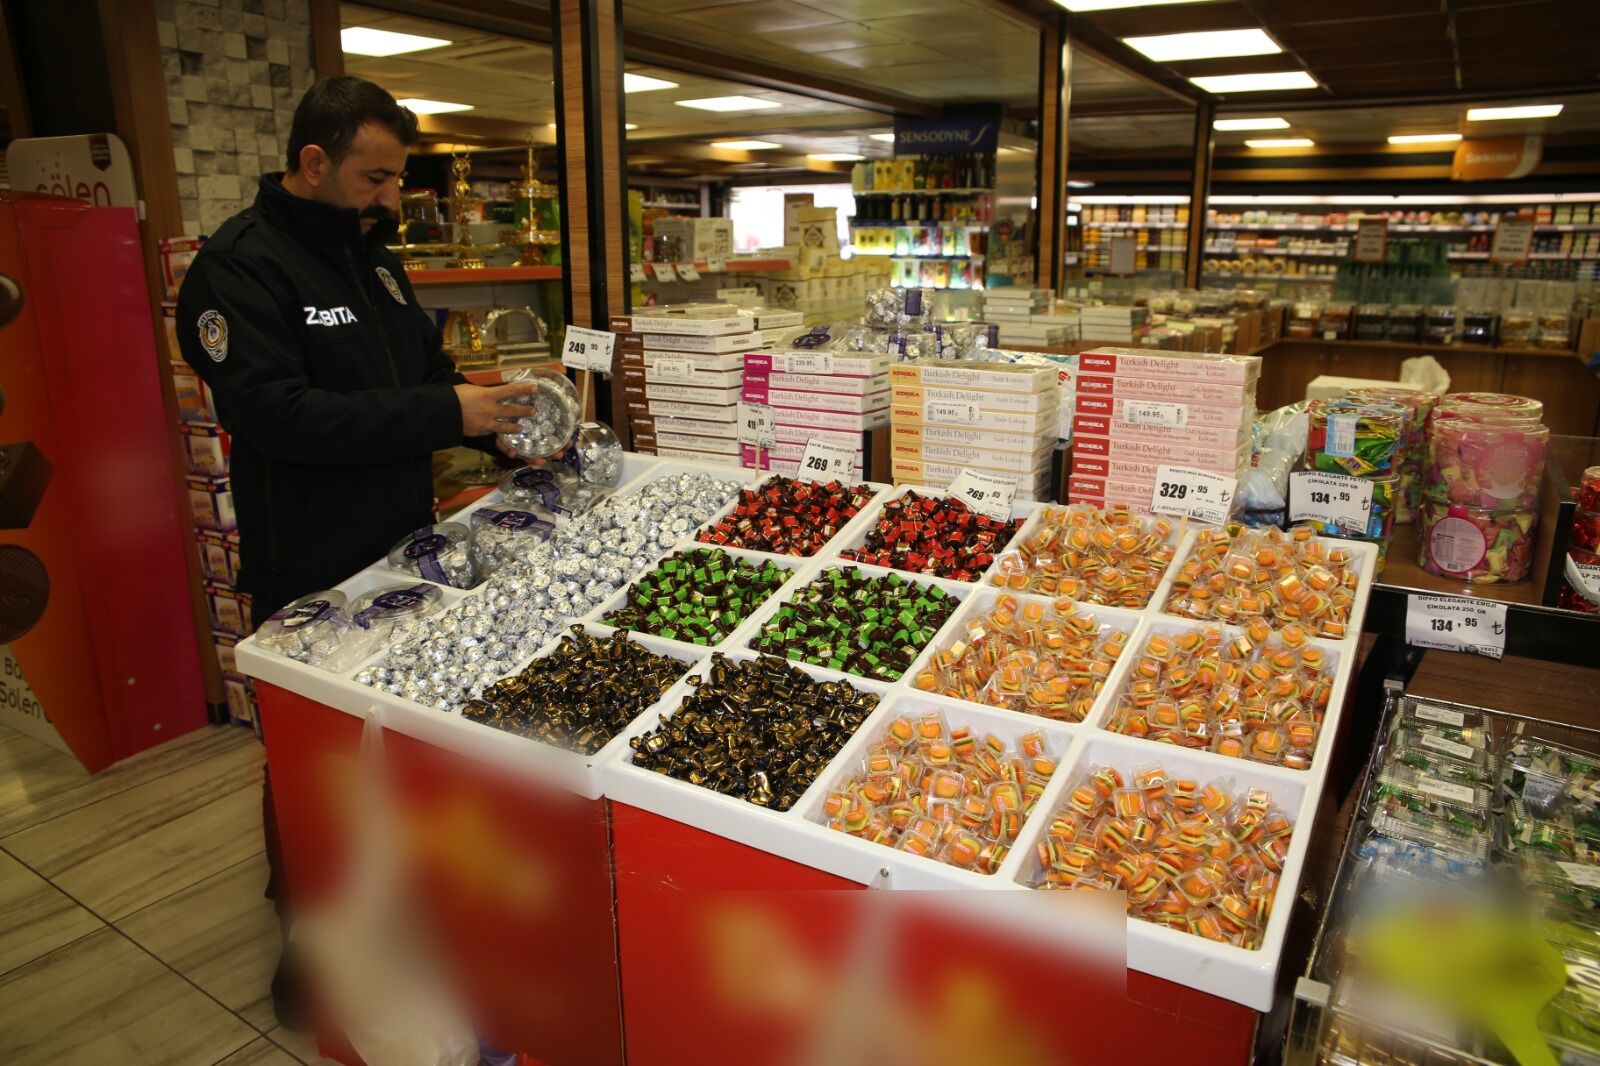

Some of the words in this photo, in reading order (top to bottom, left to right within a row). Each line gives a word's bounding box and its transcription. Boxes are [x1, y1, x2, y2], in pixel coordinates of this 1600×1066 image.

[900, 129, 971, 143] SENSODYNE
[303, 307, 358, 326] ZBITA
[568, 341, 586, 354] 249
[1119, 358, 1149, 367] Turkish
[1149, 359, 1179, 370] Delight
[770, 374, 795, 382] Turkish
[796, 375, 820, 385] Delight
[923, 369, 951, 379] Turkish
[952, 371, 980, 382] Delight
[1116, 380, 1147, 390] Turkish
[1147, 382, 1176, 392] Delight
[770, 391, 794, 400] Turkish
[795, 393, 819, 403] Delight
[927, 389, 956, 399] Turkish
[956, 391, 984, 402] Delight
[796, 411, 820, 421] Delight
[925, 428, 953, 438] Turkish
[953, 430, 981, 441] Delight
[924, 446, 952, 456] Turkish
[953, 448, 980, 460] Delight
[1112, 442, 1141, 451] Turkish
[1142, 444, 1172, 455] Delight
[806, 456, 828, 471] 269
[834, 459, 842, 467] 95
[925, 465, 954, 474] Turkish
[1112, 463, 1141, 472] Turkish
[966, 488, 984, 500] 269
[1108, 483, 1137, 492] Turkish
[1160, 482, 1187, 500] 329
[1197, 485, 1208, 494] 95
[1310, 491, 1330, 504] 134
[1340, 492, 1350, 502] 95
[1440, 597, 1474, 605] ELEGANTE
[1431, 618, 1453, 632] 134
[1465, 617, 1478, 627] 95
